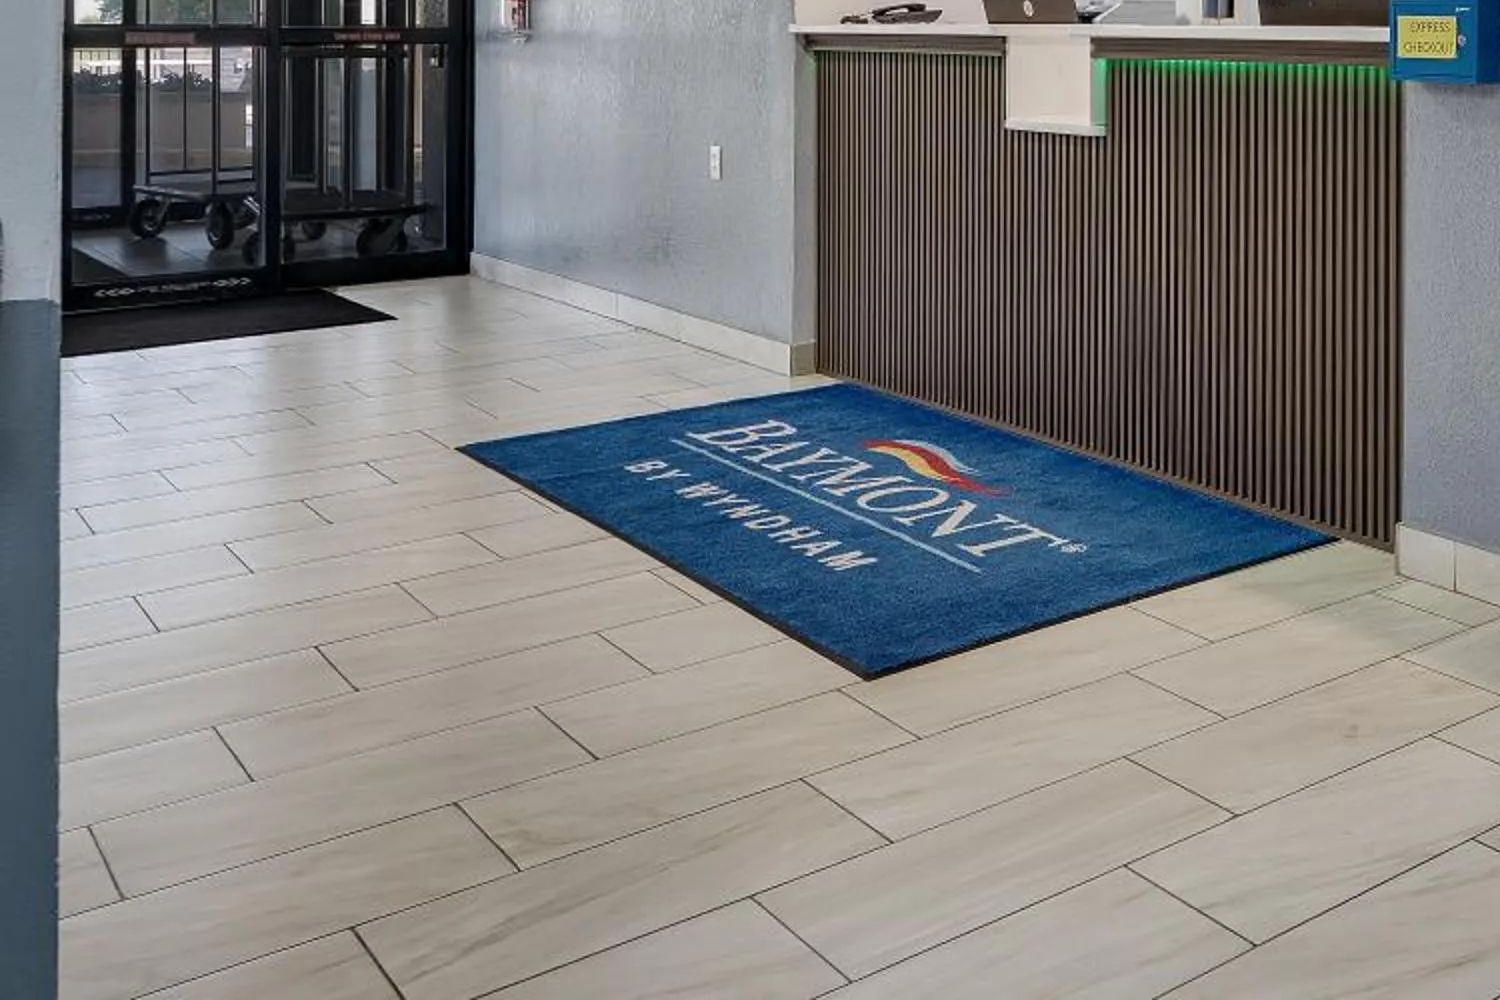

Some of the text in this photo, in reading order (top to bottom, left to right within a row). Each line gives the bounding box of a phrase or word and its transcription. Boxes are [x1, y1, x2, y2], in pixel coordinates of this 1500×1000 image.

[1403, 41, 1453, 55] CHECKOUT
[1409, 21, 1452, 33] EXPRESS
[624, 458, 879, 572] BY WYNDHAM
[685, 418, 1073, 558] BAYMONT
